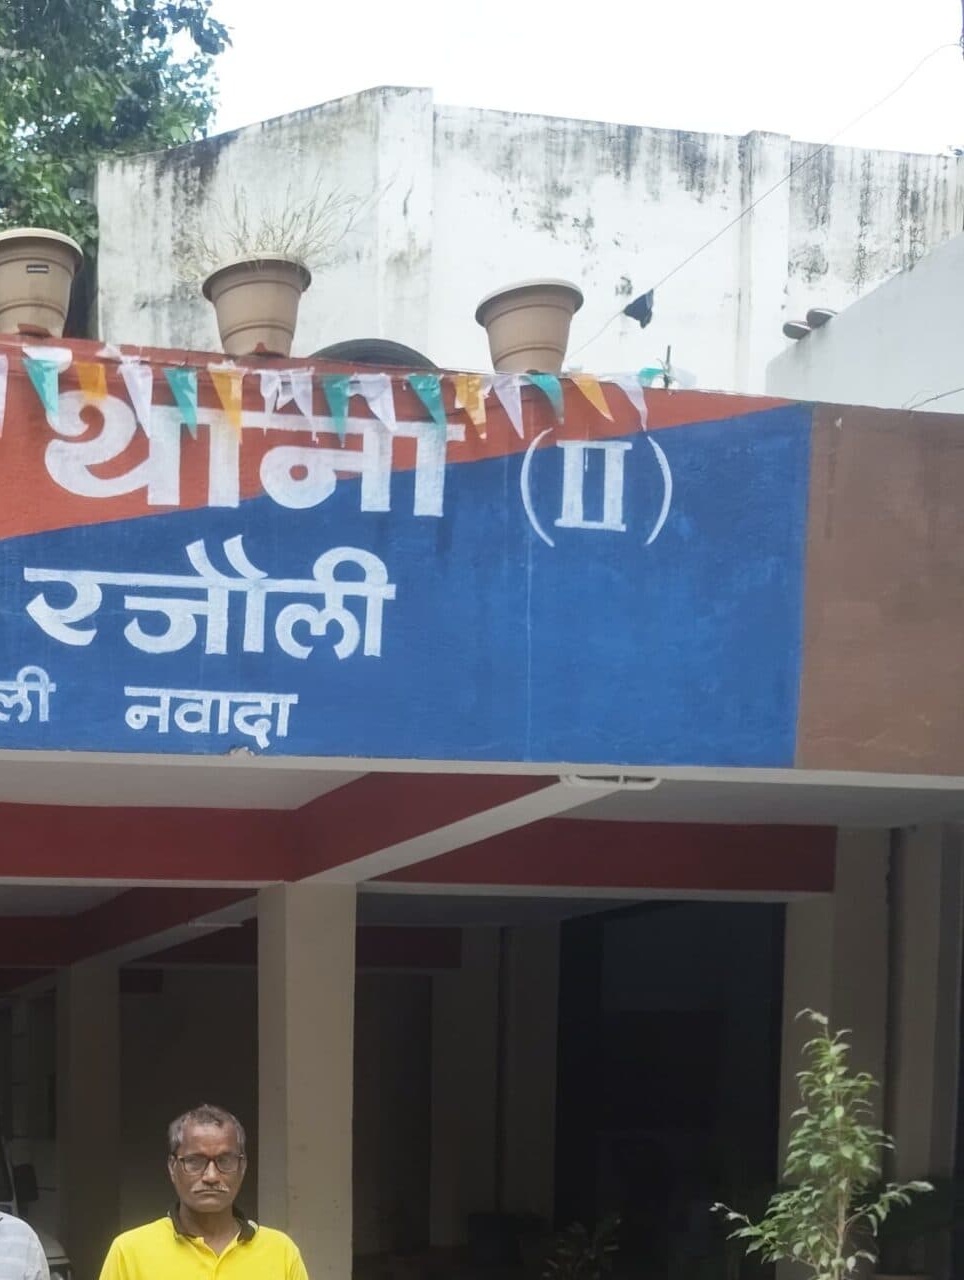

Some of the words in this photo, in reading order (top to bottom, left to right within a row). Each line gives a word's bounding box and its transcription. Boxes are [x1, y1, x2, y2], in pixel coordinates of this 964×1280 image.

[44, 390, 466, 517] थाना
[23, 533, 396, 659] रजौली
[124, 685, 299, 749] नवादा
